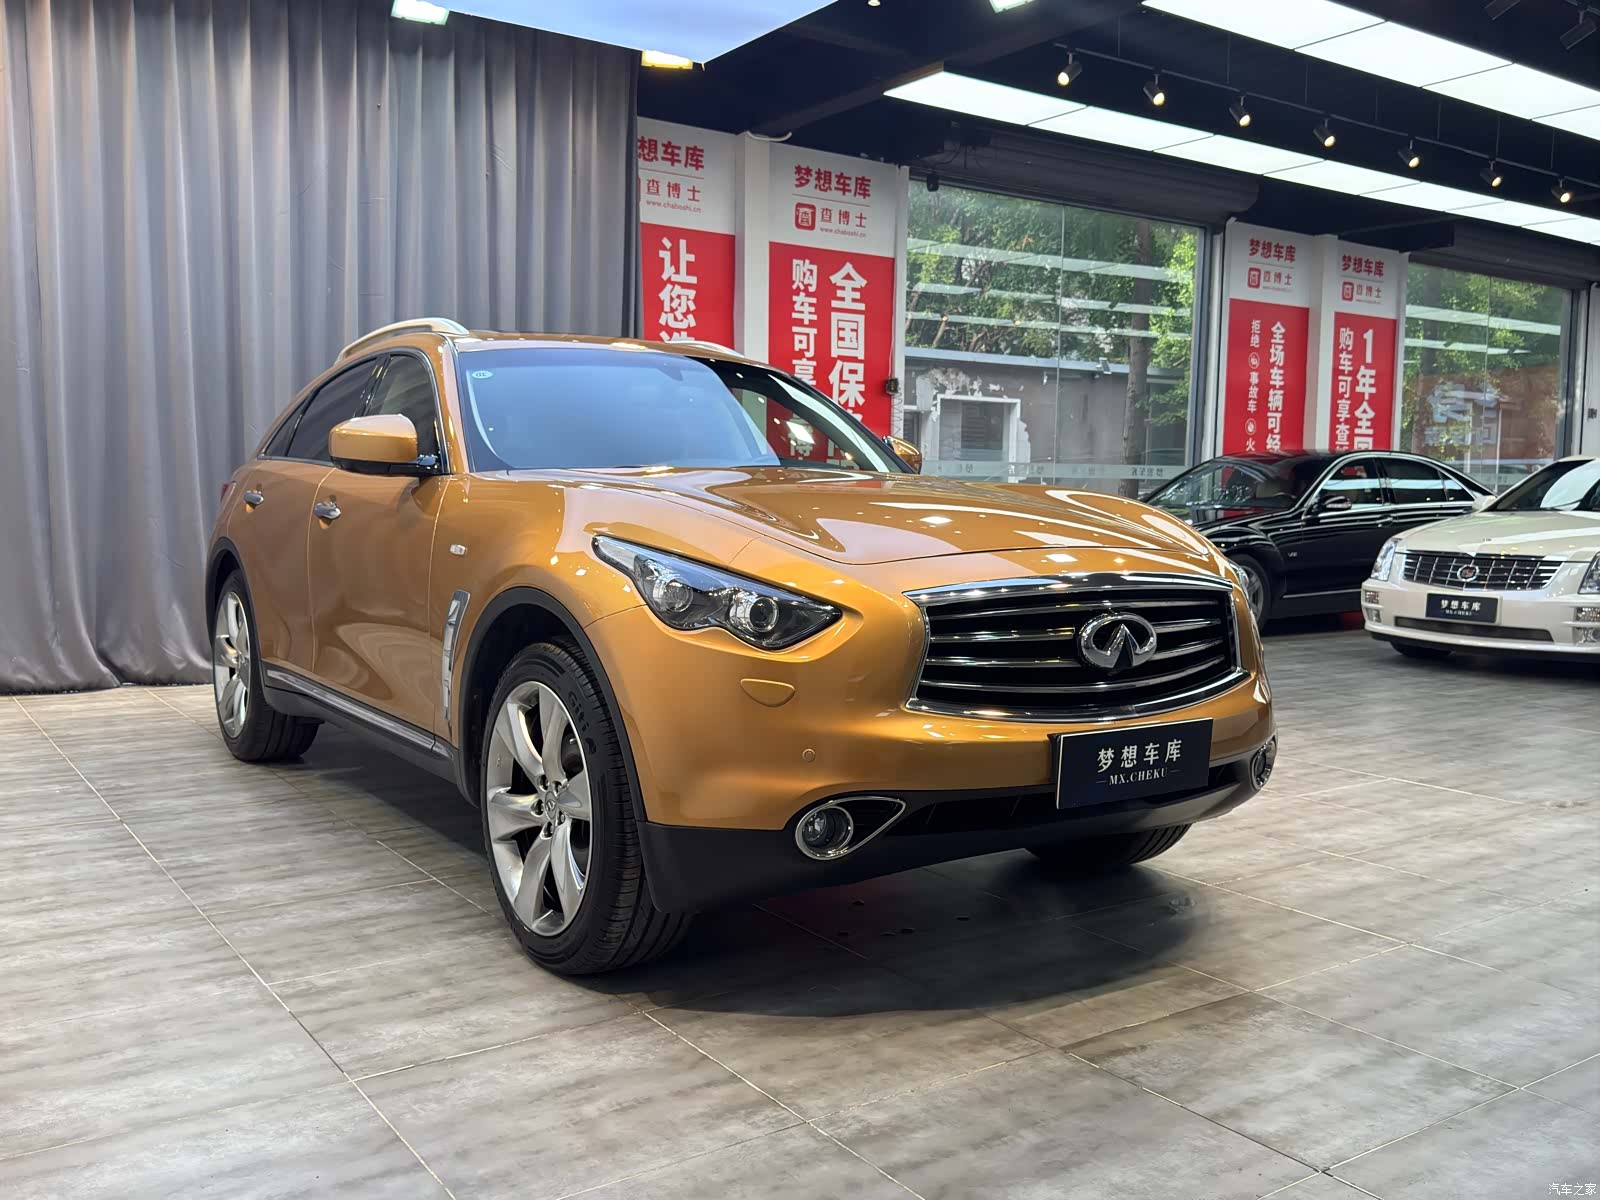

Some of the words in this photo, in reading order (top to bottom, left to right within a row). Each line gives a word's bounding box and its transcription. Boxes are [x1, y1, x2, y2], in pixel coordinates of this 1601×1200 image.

[646, 179, 701, 202] 查博士
[794, 165, 871, 199] 梦想车库
[820, 207, 867, 229] 查博士
[1249, 238, 1296, 263] 梦想车库
[1342, 254, 1384, 277] 梦想车库
[828, 262, 866, 421] 全国保
[1335, 328, 1354, 450] 购车可享查
[1441, 599, 1481, 611] 梦想车库
[1097, 739, 1182, 773] 梦想车库
[1109, 767, 1168, 785] MX.CHEKU
